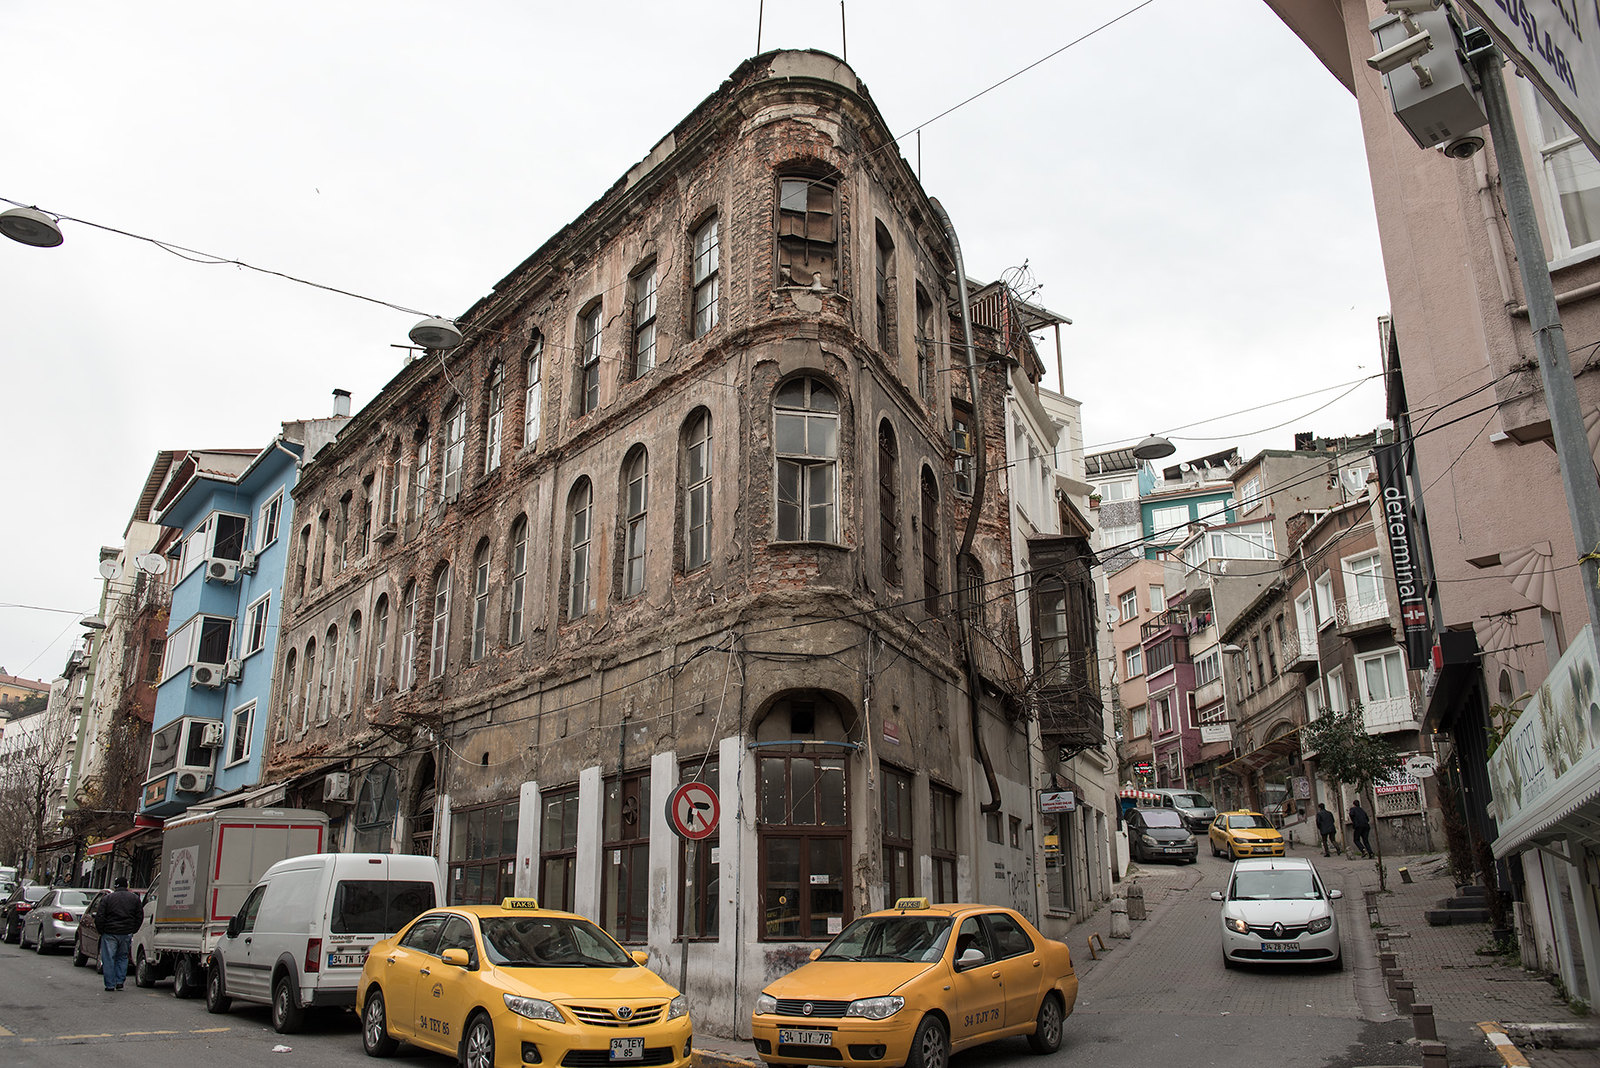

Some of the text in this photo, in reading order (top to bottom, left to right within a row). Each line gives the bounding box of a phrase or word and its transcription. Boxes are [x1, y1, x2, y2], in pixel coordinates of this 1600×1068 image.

[1384, 487, 1423, 605] determinal
[333, 955, 342, 964] 34
[345, 955, 354, 964] TN
[964, 1008, 1000, 1028] 34 TJY 78
[420, 1015, 450, 1036] 34 TEY 85
[613, 1039, 642, 1049] 34 TEY
[784, 1031, 830, 1044] 34 TJY 78
[623, 1048, 633, 1057] 85
